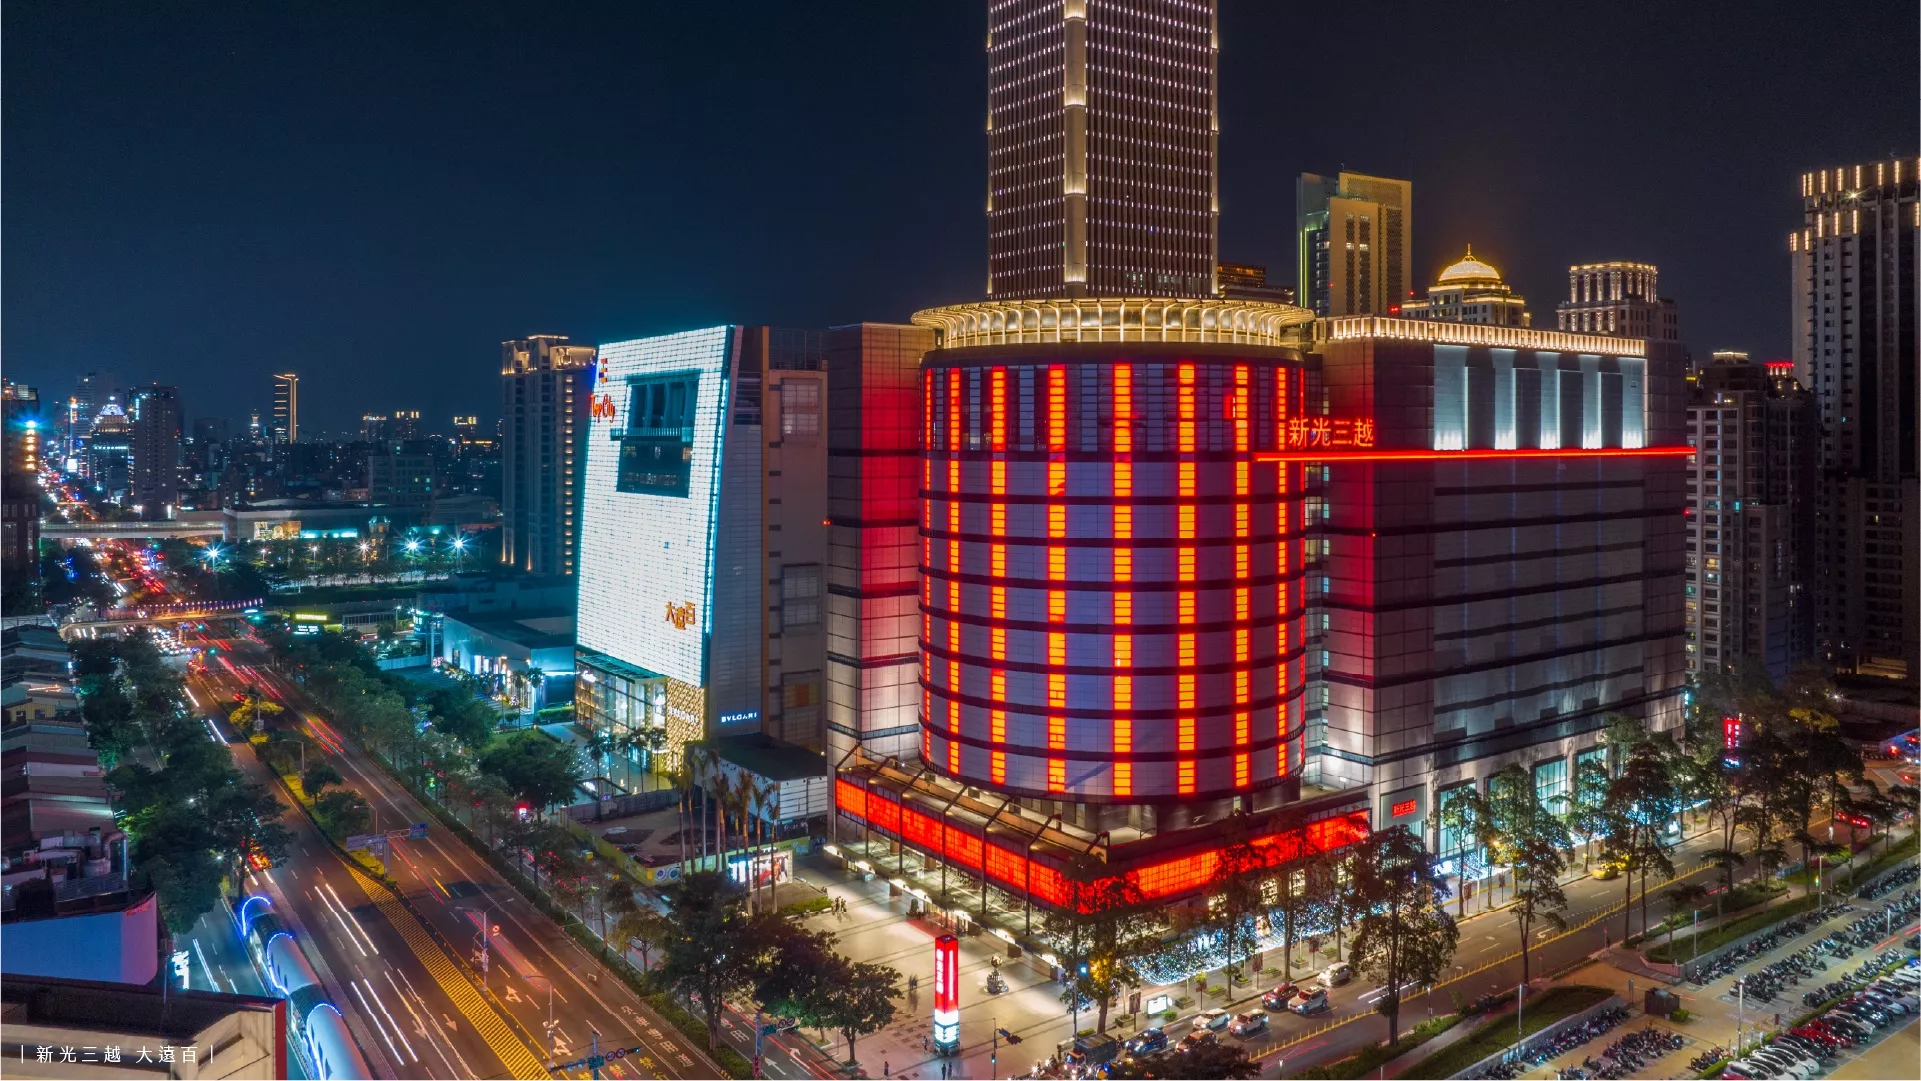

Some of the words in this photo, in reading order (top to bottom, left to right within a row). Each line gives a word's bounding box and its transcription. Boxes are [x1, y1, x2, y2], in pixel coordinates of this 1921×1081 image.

[1288, 417, 1374, 447] 新光三越
[665, 601, 695, 630] 大遠百
[721, 712, 758, 723] BVLGARI
